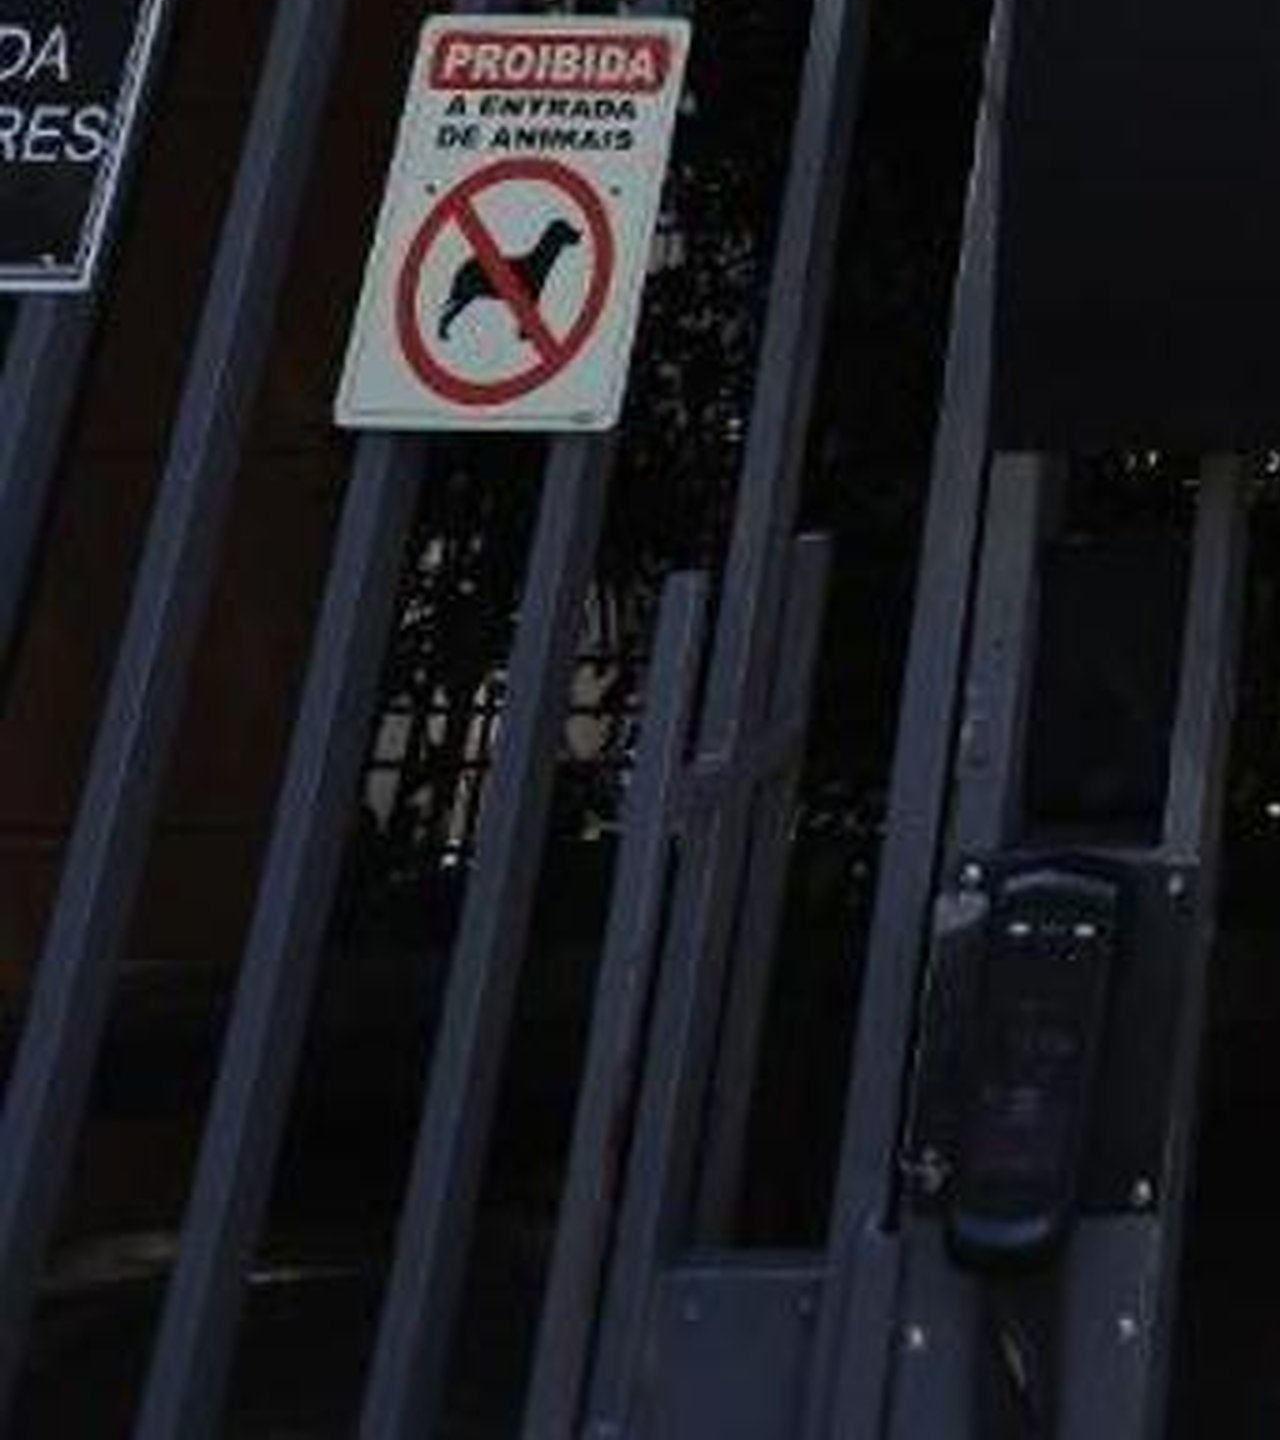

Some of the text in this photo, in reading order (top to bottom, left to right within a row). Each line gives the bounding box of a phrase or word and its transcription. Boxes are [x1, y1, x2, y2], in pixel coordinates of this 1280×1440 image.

[441, 40, 660, 82] PROIBIDA
[446, 95, 638, 121] A ENTRADA
[437, 126, 635, 151] DE ANIMAIS
